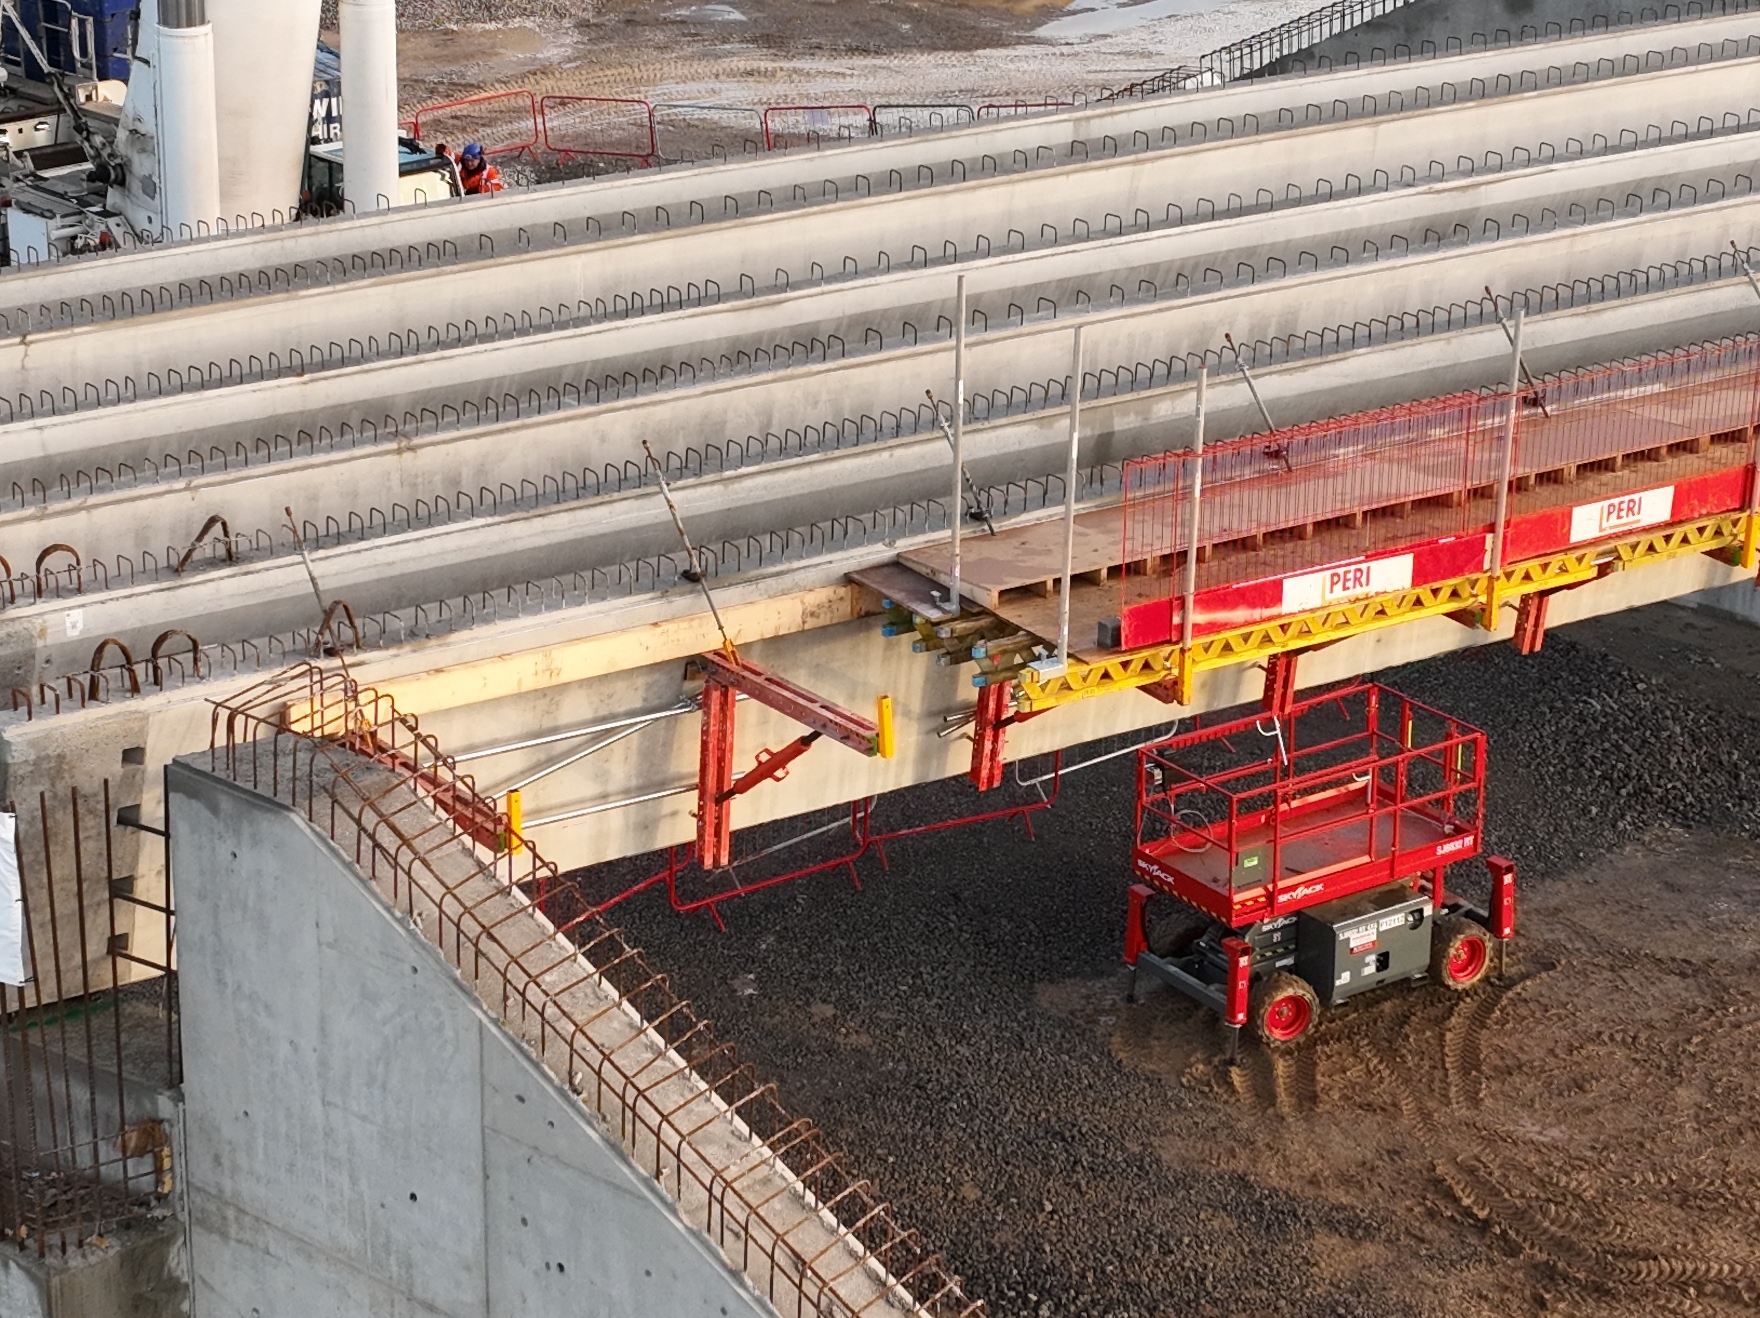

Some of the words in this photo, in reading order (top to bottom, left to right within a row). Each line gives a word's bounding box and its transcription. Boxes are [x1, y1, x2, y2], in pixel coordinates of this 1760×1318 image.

[1606, 496, 1643, 523] PERI
[1329, 565, 1371, 594] PERI
[1137, 858, 1175, 886] SKYJACK
[1277, 883, 1325, 903] SKYJACK
